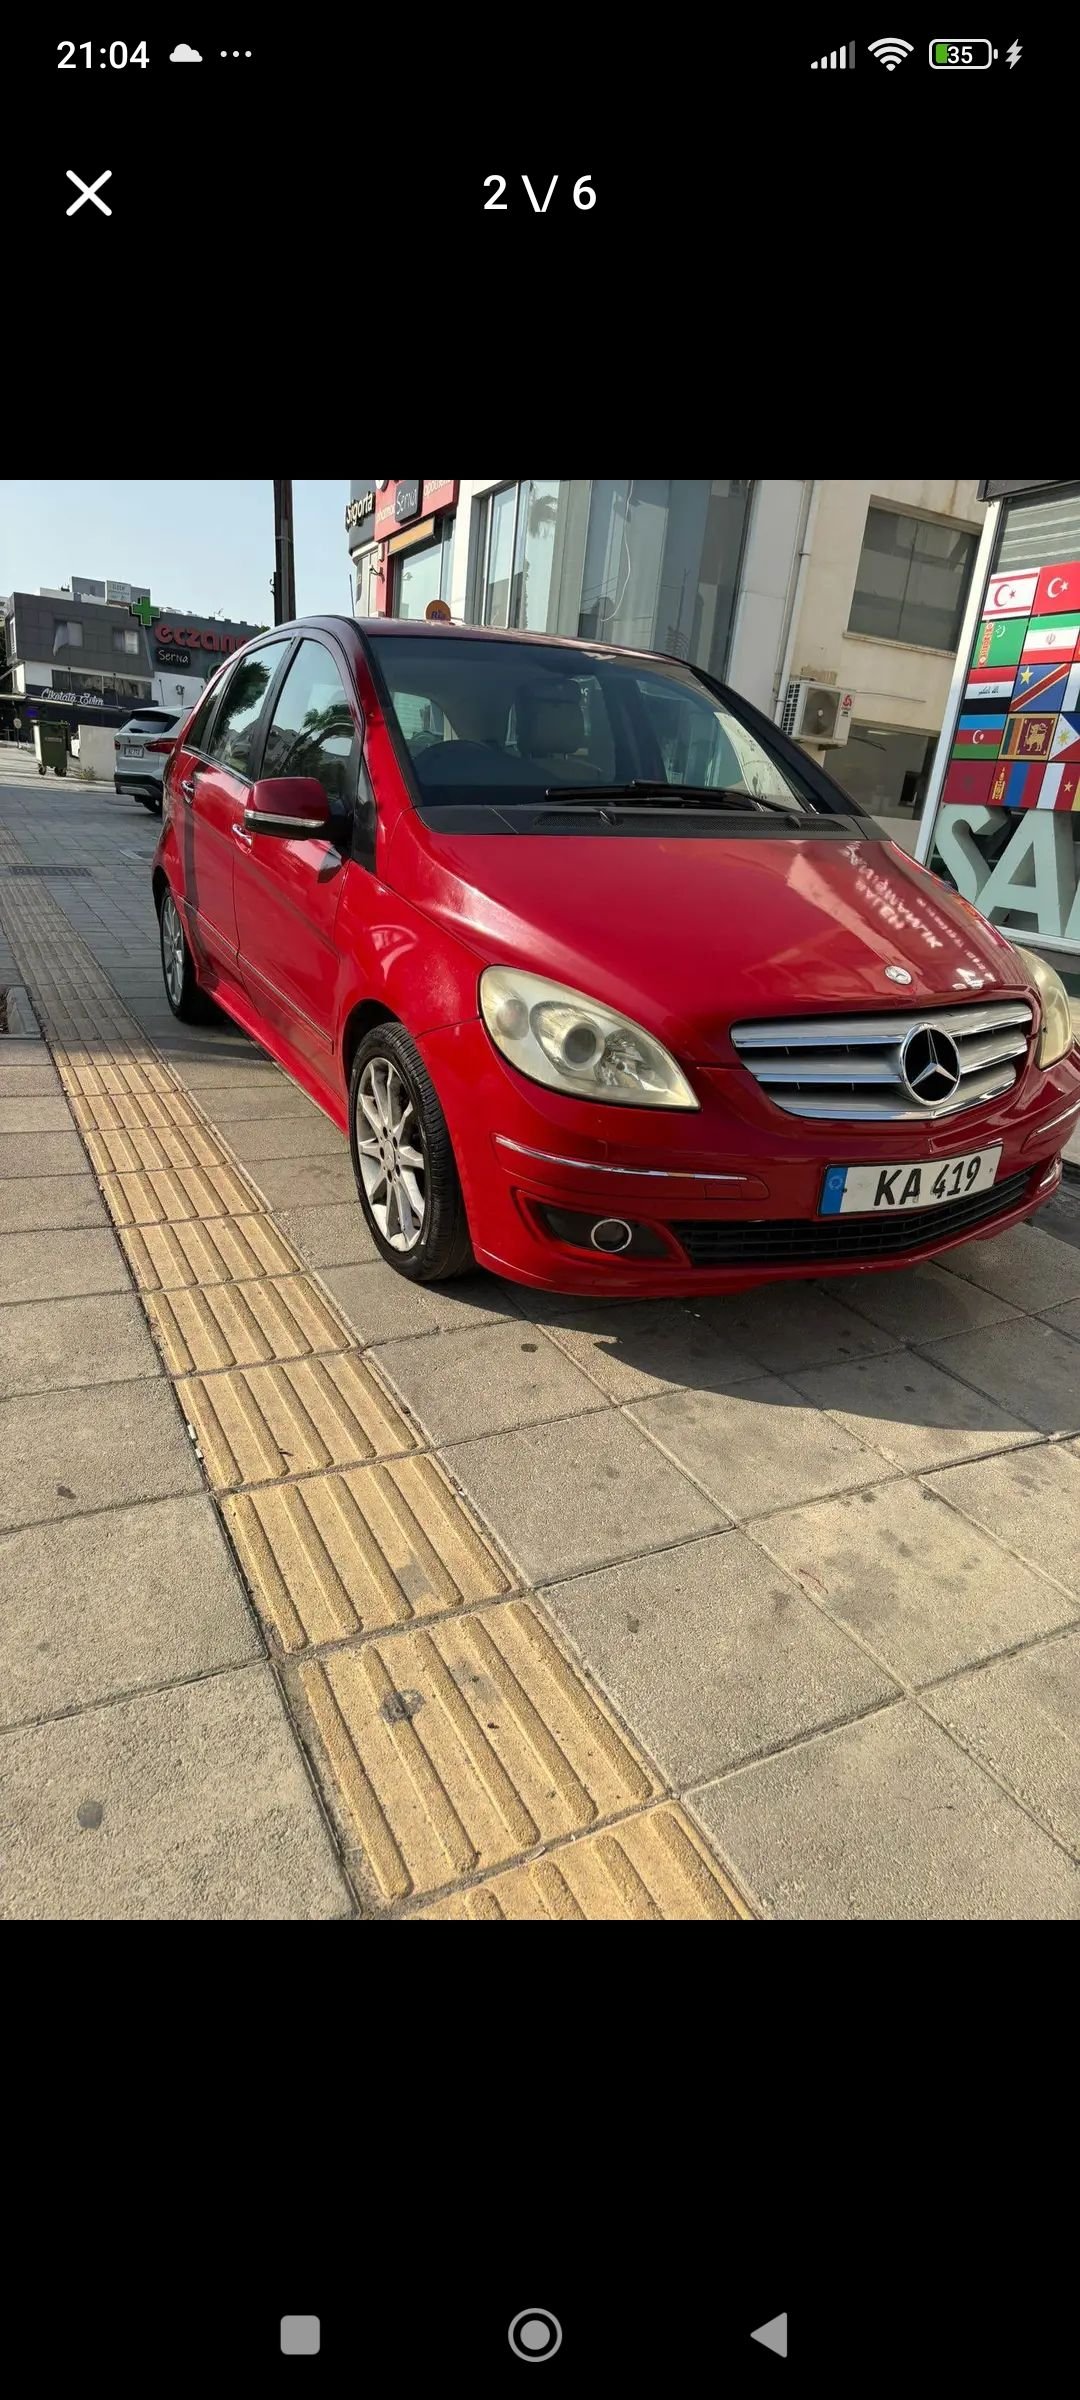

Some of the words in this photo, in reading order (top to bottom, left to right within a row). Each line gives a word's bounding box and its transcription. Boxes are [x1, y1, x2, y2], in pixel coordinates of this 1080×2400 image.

[934, 803, 1080, 940] SA
[873, 1168, 922, 1206] KA
[931, 1155, 982, 1200] 419
